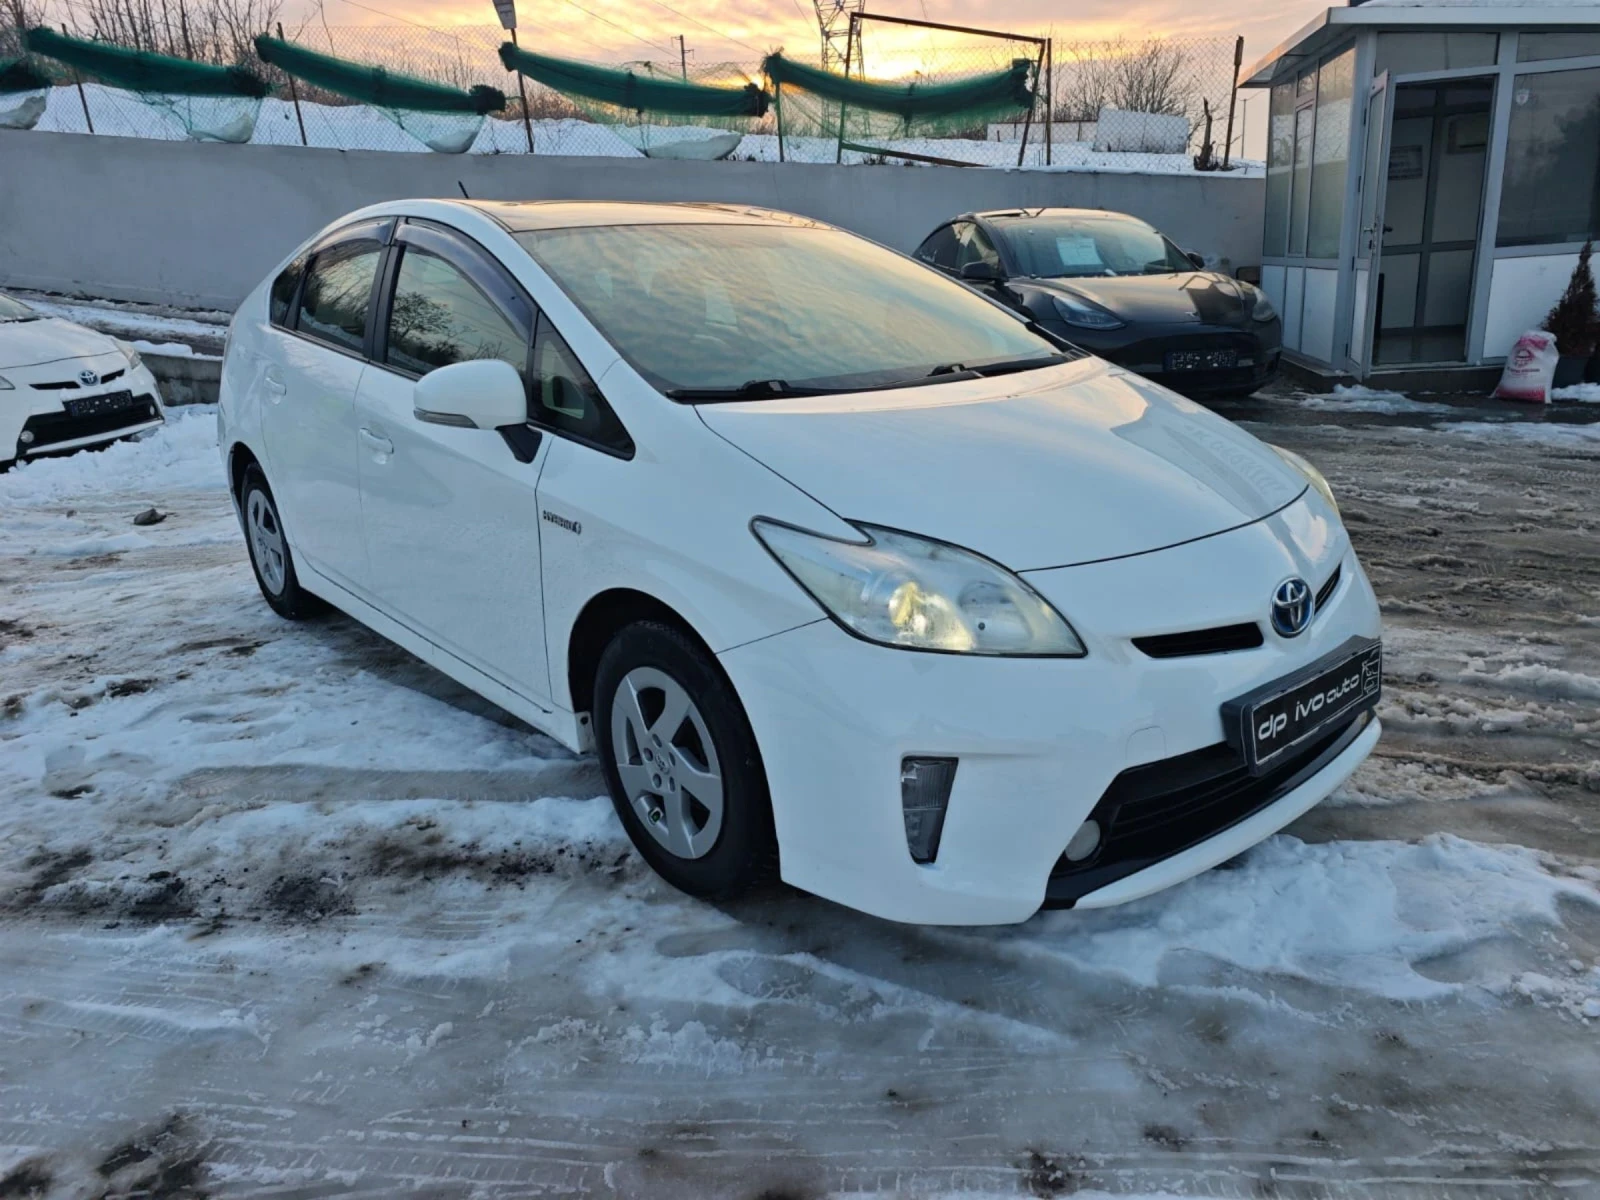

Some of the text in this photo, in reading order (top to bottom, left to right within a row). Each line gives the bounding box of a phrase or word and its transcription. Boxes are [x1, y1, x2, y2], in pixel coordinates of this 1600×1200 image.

[1258, 673, 1360, 741] dp ivo auto
